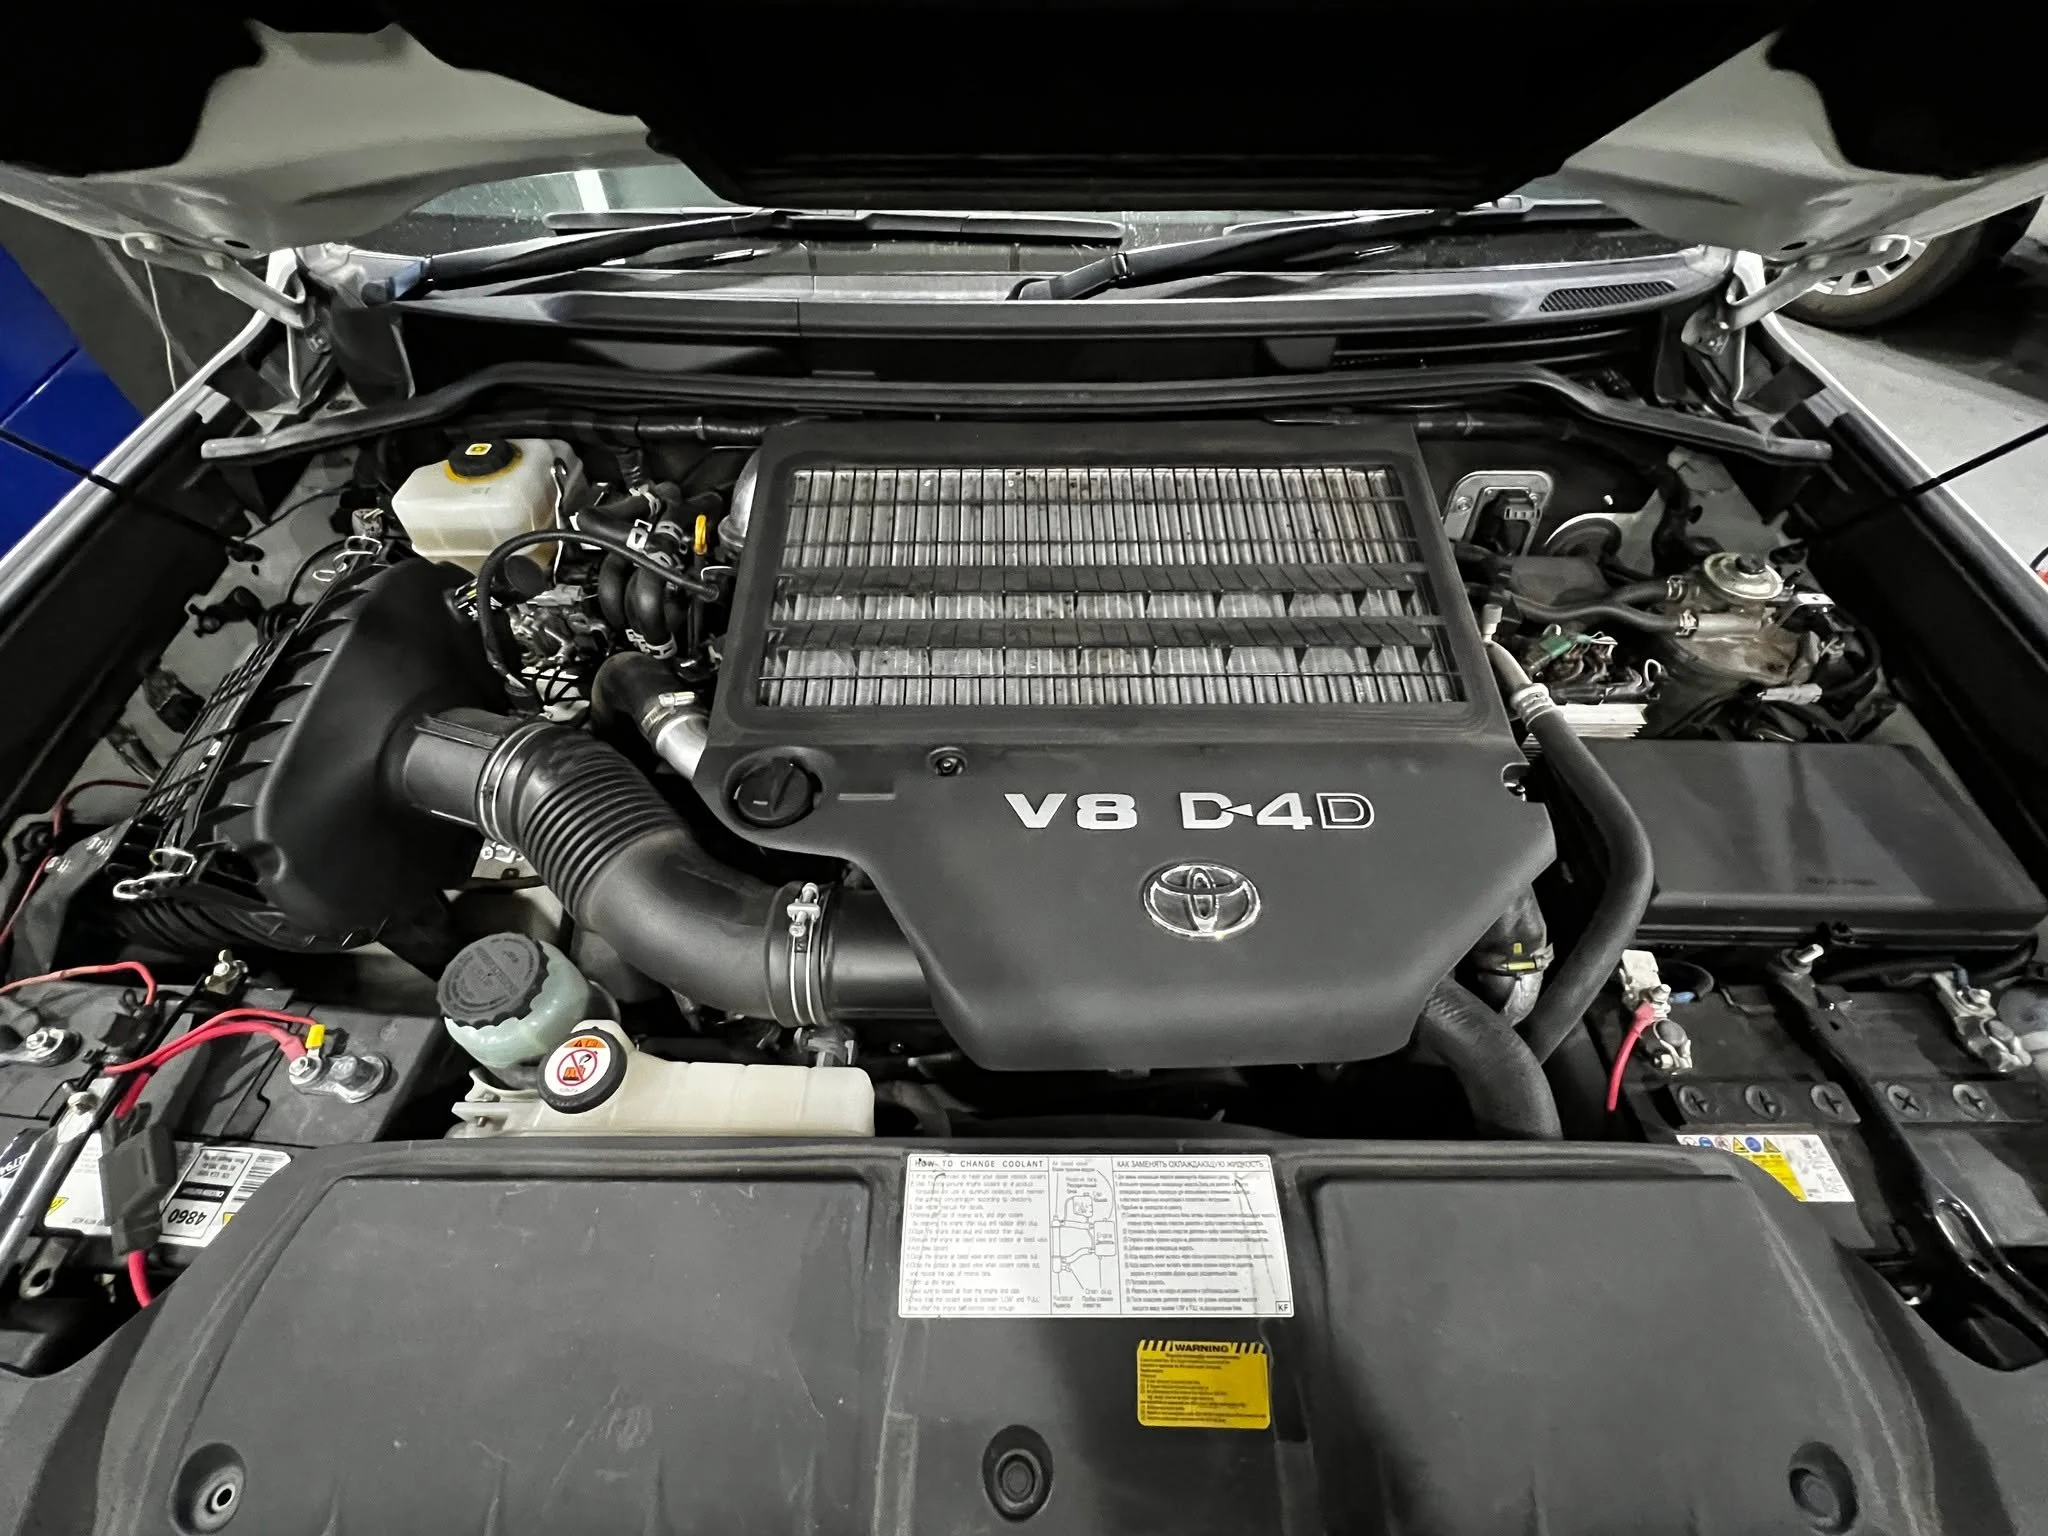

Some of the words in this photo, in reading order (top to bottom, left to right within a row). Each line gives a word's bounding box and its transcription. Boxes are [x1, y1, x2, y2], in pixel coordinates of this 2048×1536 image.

[1004, 793, 1138, 830] V8
[914, 1160, 935, 1168] HOW
[942, 1160, 953, 1168] TO
[960, 1160, 995, 1168] CHANGE
[1002, 1160, 1044, 1168] COOLANT
[1117, 1160, 1130, 1168] КАК
[167, 1208, 208, 1226] 4860
[1277, 1301, 1289, 1311] KF
[1174, 1343, 1230, 1353] WARNING
